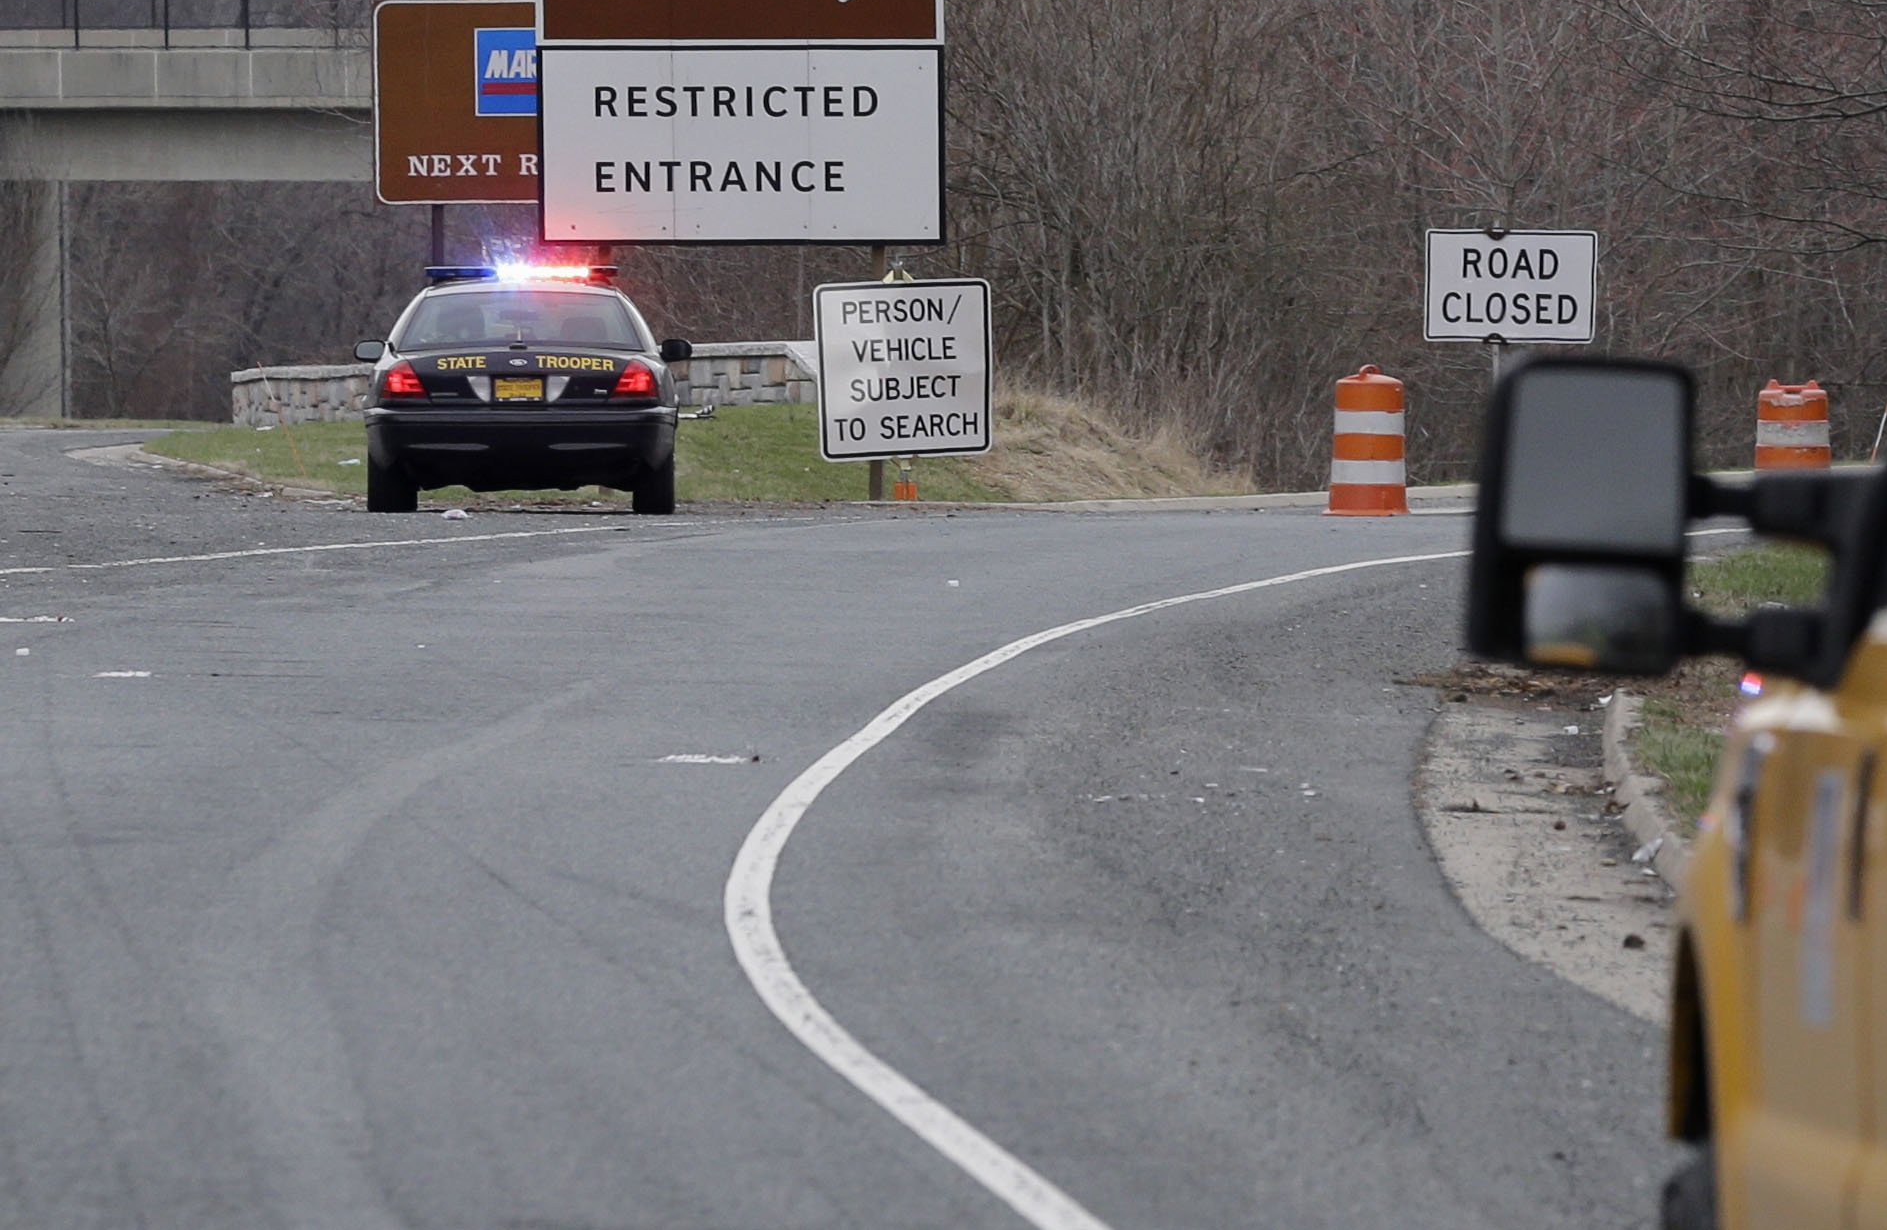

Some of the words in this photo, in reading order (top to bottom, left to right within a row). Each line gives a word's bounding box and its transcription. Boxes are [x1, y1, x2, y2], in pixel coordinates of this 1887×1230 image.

[594, 85, 879, 118] RESTRICTED
[407, 154, 502, 178] NEXT
[595, 160, 845, 192] ENTRANCE
[1462, 247, 1559, 280] ROAD
[841, 294, 962, 325] PERSON/
[1442, 291, 1578, 325] CLOSED
[436, 355, 487, 370] STATE
[535, 354, 615, 372] TROOPER
[851, 336, 957, 363] VEHICLE
[850, 375, 961, 402] SUBJECT
[834, 417, 866, 441] TO
[880, 412, 978, 439] SEARCH
